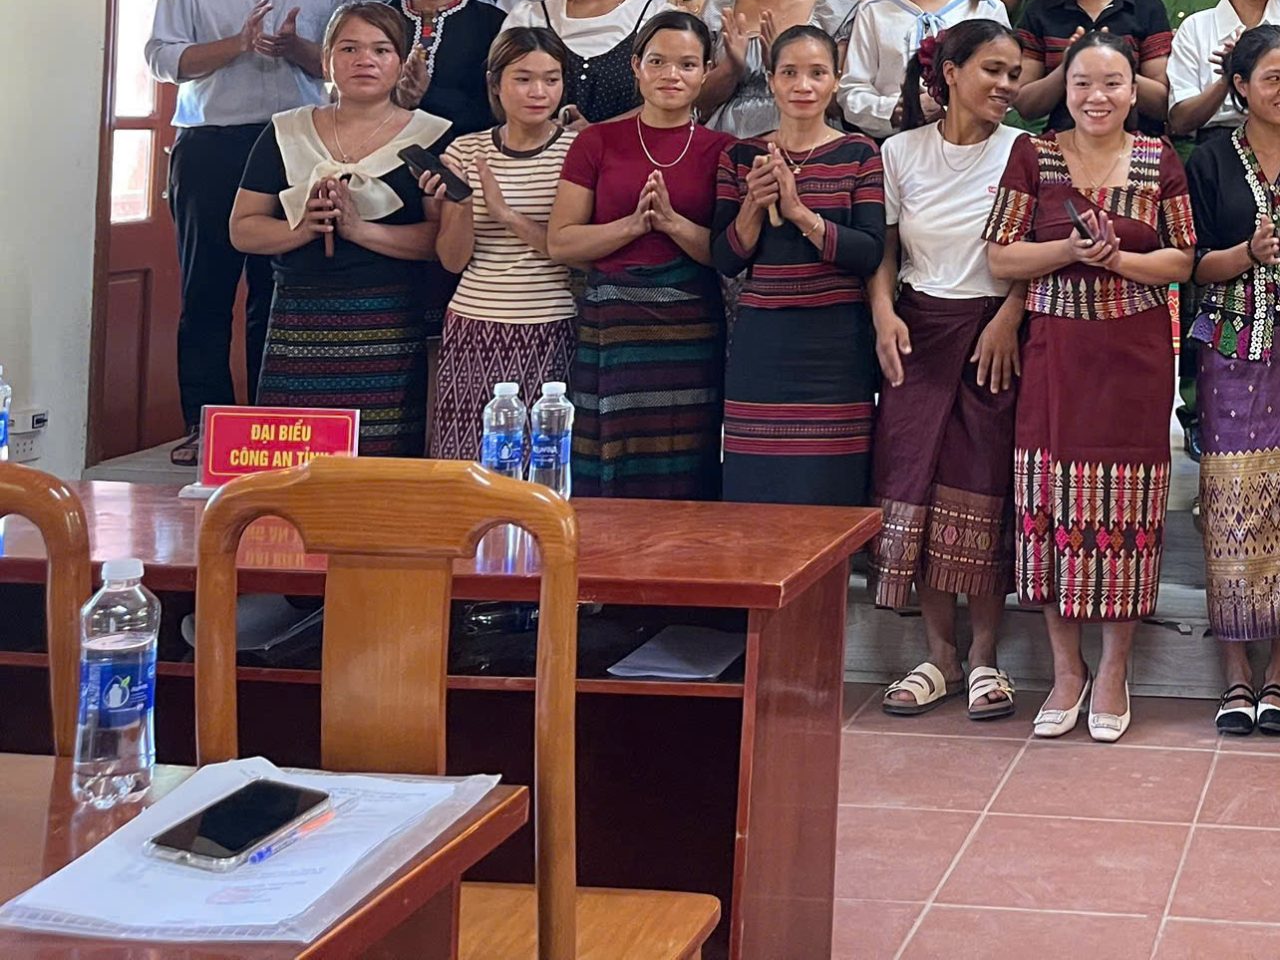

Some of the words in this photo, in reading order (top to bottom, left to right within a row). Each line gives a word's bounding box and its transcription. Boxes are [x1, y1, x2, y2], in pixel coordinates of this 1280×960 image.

[250, 424, 276, 444] ĐẠI
[278, 419, 312, 442] BIỂU
[230, 447, 269, 467] CÔNG
[272, 450, 293, 467] AN
